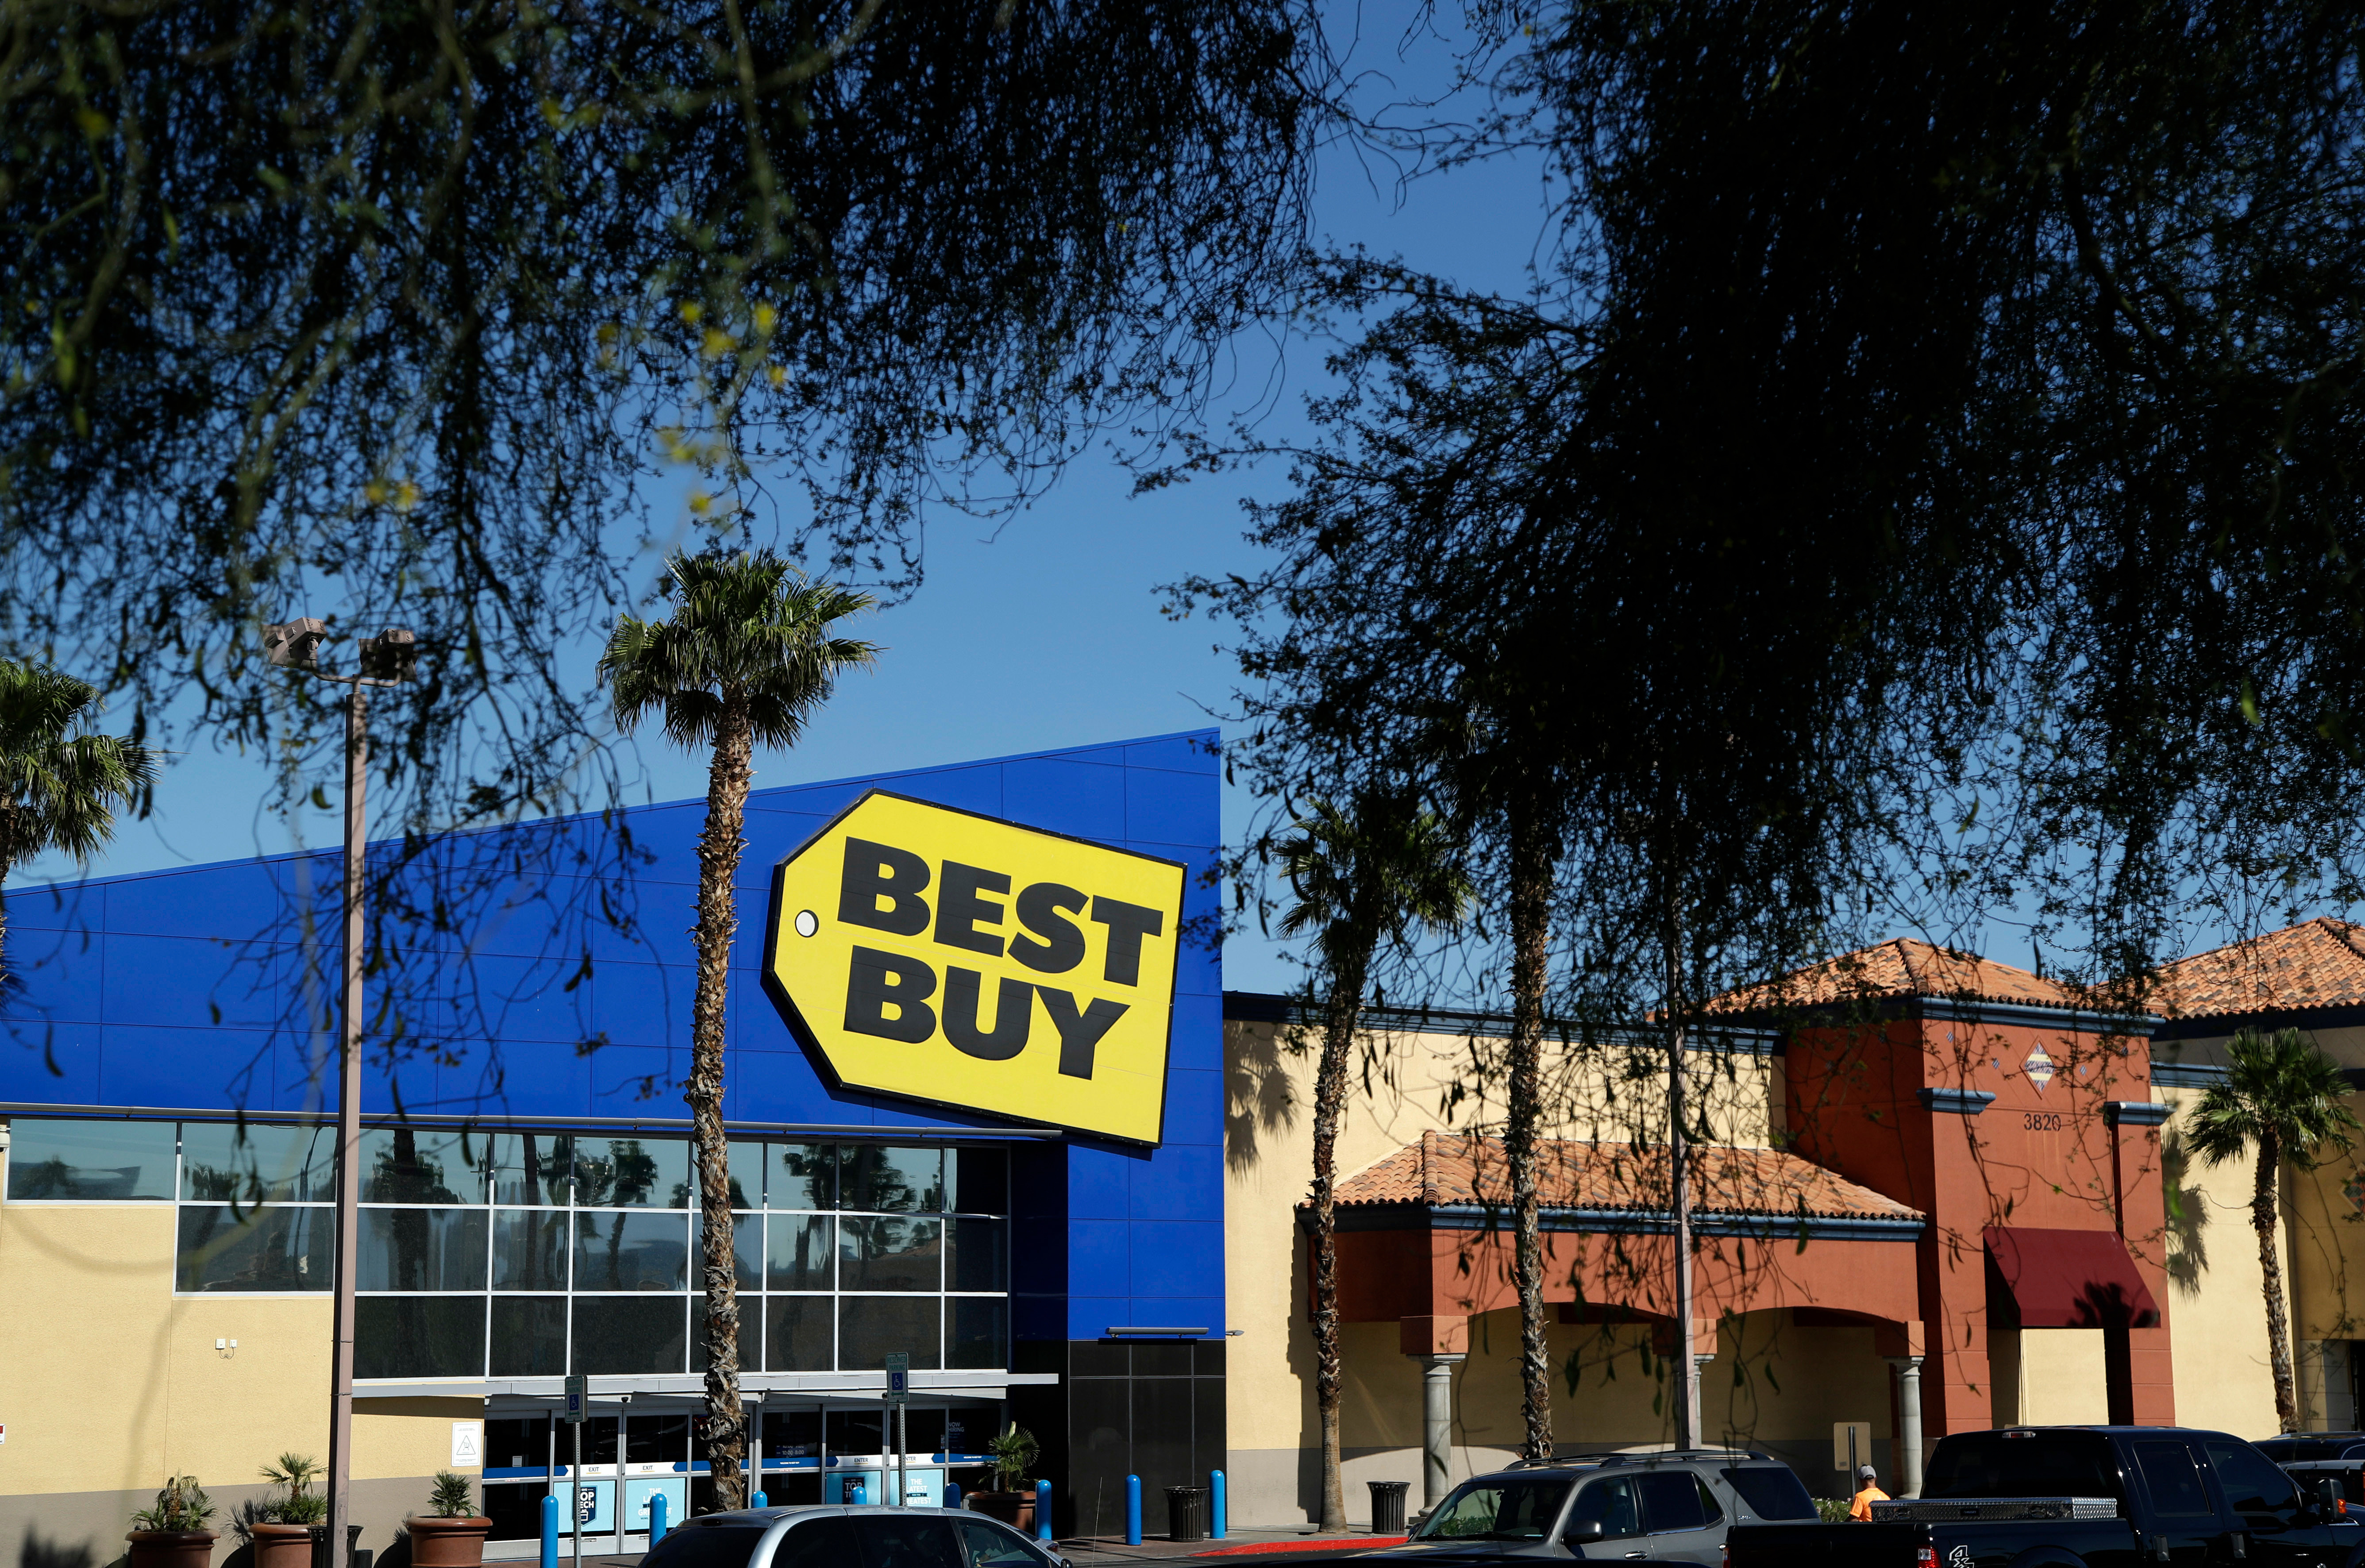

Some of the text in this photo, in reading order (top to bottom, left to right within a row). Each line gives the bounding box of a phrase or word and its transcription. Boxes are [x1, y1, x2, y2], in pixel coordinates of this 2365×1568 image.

[837, 836, 1163, 987] BEST
[843, 944, 1131, 1081] BUY
[2024, 1113, 2061, 1131] 3820
[580, 1491, 594, 1501] OP
